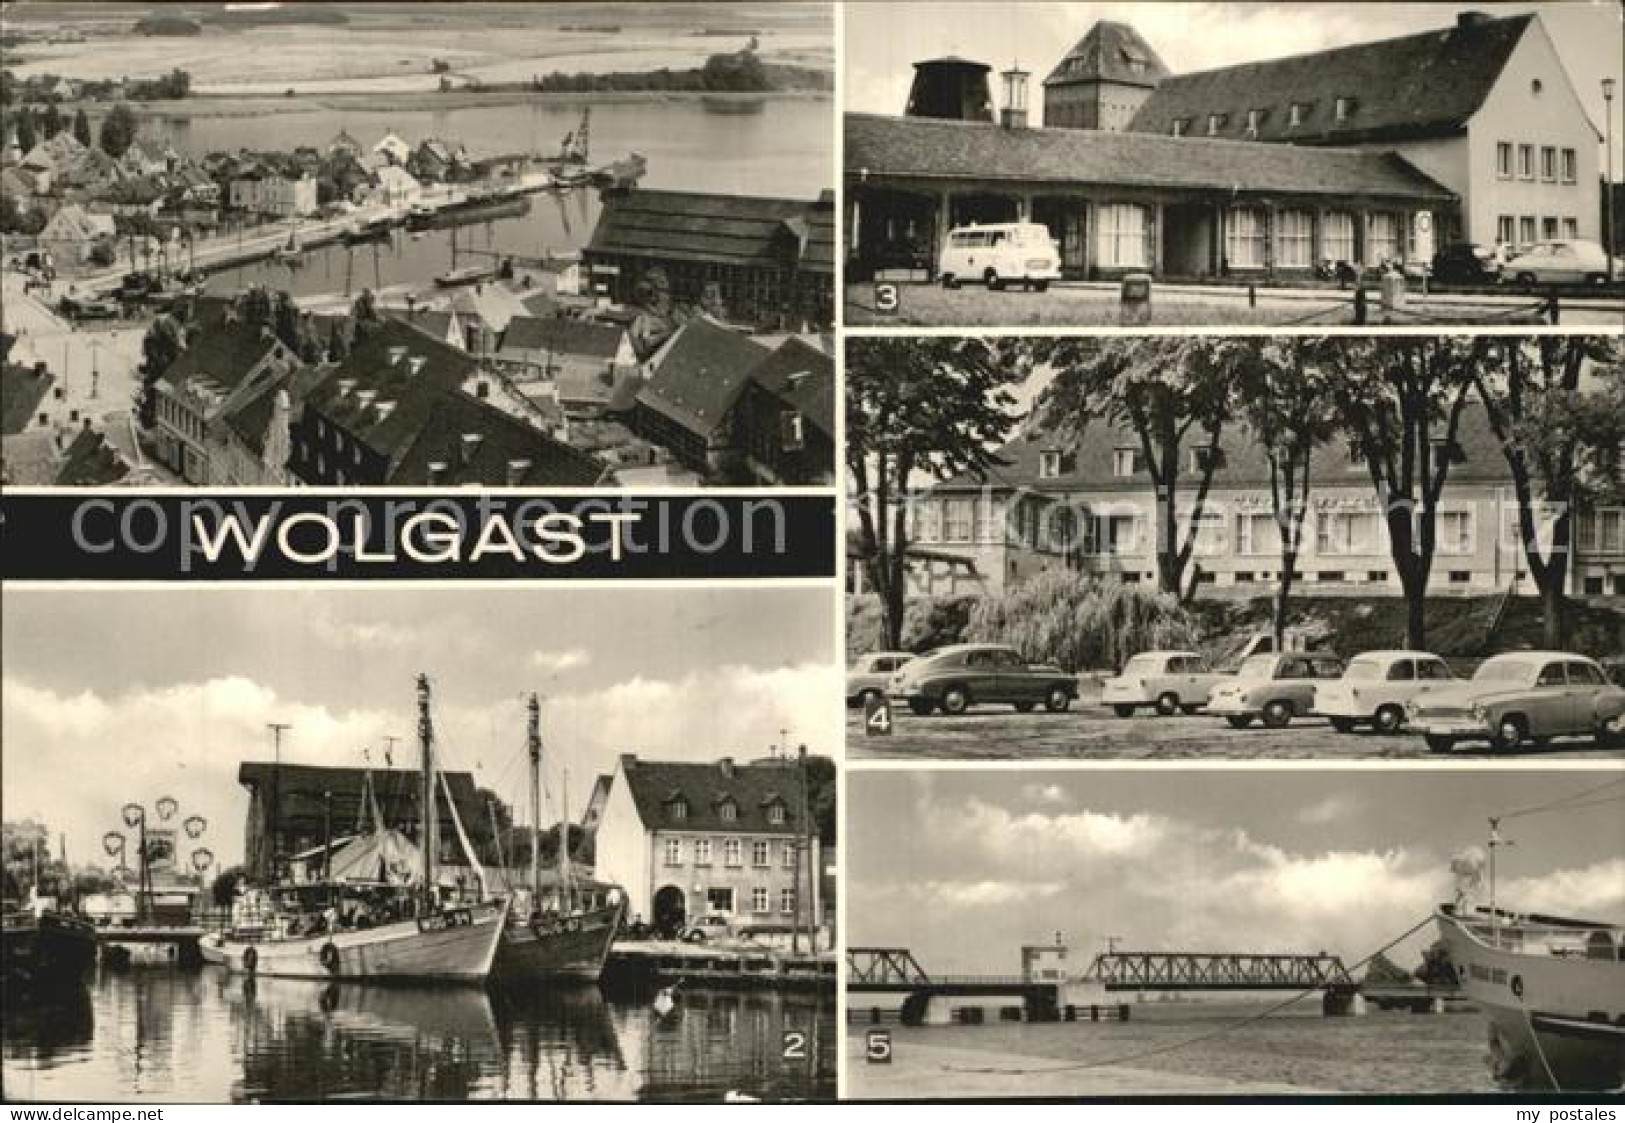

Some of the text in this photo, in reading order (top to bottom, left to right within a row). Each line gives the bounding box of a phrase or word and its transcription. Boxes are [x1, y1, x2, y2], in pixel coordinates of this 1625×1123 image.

[877, 285, 897, 310] 3
[791, 417, 802, 441] 1
[192, 512, 642, 563] WOLGAST
[868, 706, 890, 731] 4
[784, 1033, 804, 1057] 2
[868, 1035, 890, 1059] 5
